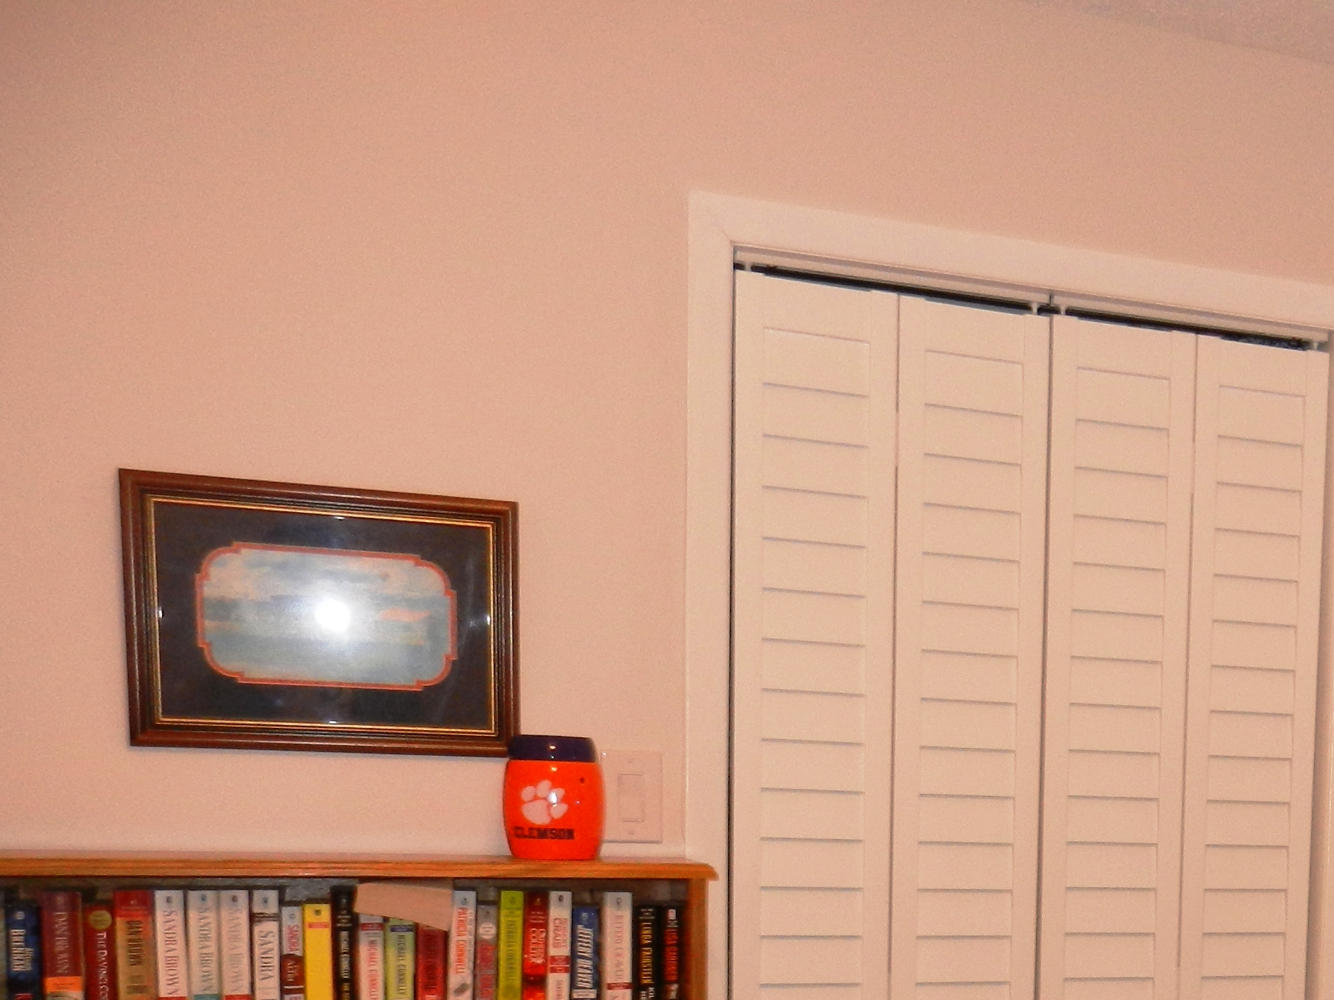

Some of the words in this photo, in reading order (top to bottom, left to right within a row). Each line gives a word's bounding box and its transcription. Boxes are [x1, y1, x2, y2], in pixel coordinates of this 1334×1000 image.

[513, 826, 575, 839] CLEMSON
[53, 911, 70, 934] DAN
[127, 920, 144, 936] DAN
[162, 910, 180, 953] SANDRA
[197, 907, 214, 952] SANDRA
[228, 907, 244, 952] SANDRA
[455, 907, 469, 937] PATRICIA
[553, 917, 563, 949] CRAIS
[639, 922, 655, 944] LINDA
[664, 929, 678, 945] LISA
[96, 931, 108, 949] THE
[287, 924, 301, 953] SANDRA
[367, 939, 380, 968] MICHAEL
[395, 934, 408, 962] MICHAEL
[577, 925, 594, 957] JEFFERY
[54, 936, 70, 974] BROWN
[257, 930, 276, 982] SANDRA
[455, 939, 469, 975] CORNWELL
[640, 946, 655, 984] FAIRSTEIN
[163, 954, 181, 995] BROWN
[199, 952, 216, 993] BROWN
[229, 952, 245, 994] BROWN
[368, 969, 380, 1000] CONNELLY
[395, 963, 408, 995] CONNELLY
[577, 958, 594, 988] DEAVER
